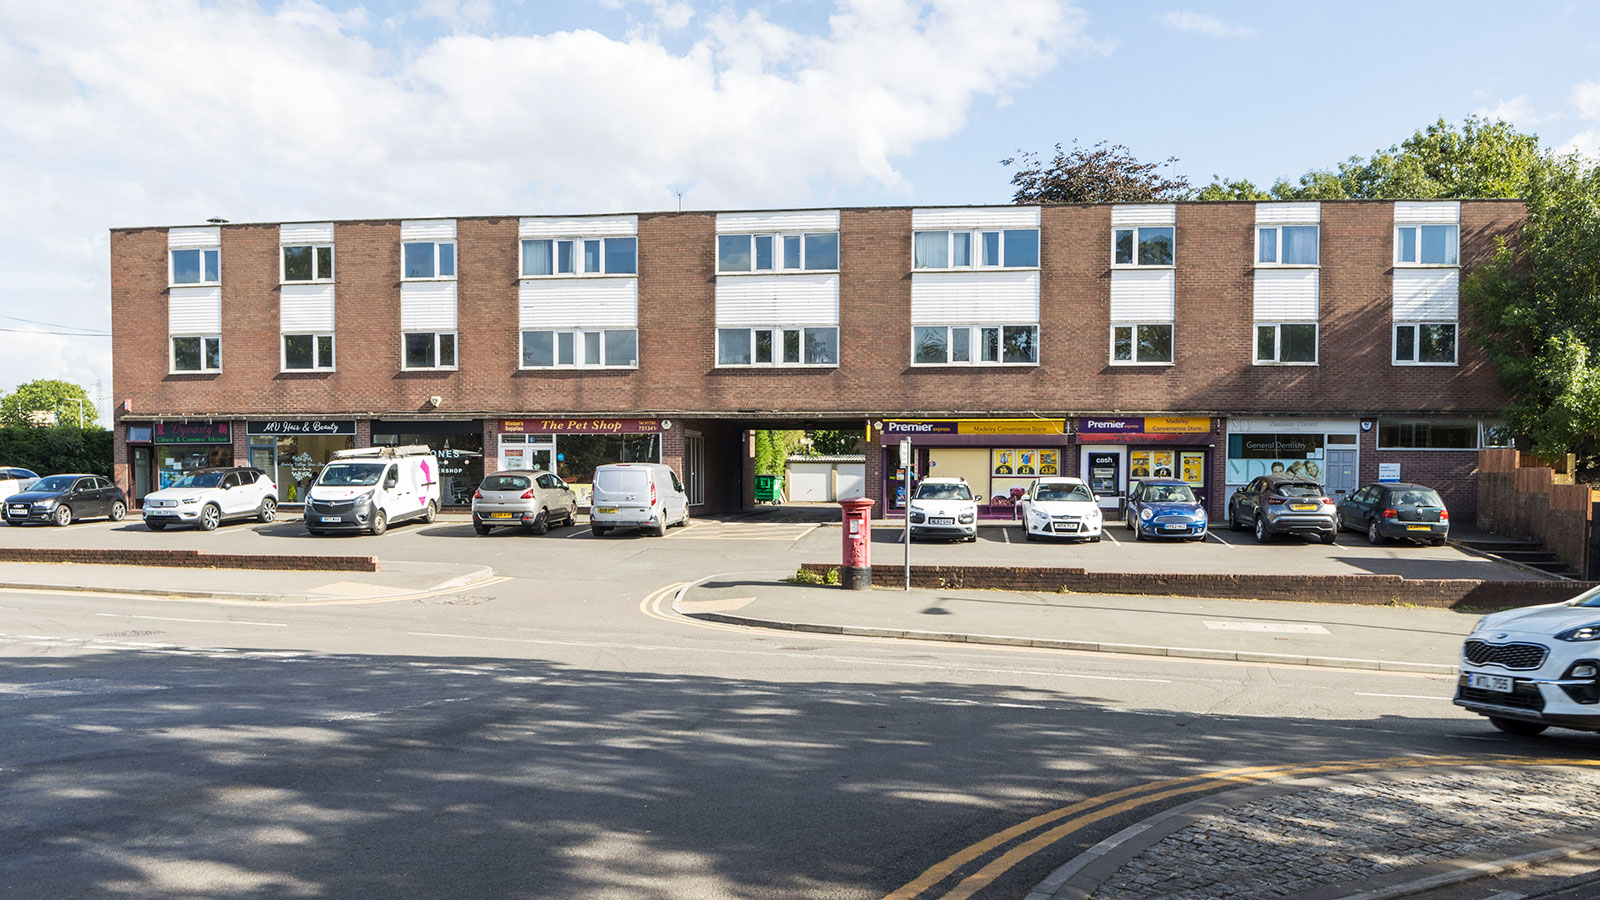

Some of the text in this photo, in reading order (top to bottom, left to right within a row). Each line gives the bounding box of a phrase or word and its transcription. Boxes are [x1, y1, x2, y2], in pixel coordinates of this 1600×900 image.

[263, 421, 339, 434] MV Hair & Beauty
[541, 420, 622, 432] The Pet Shop
[889, 421, 933, 432] Premier
[1088, 419, 1125, 429] Premier
[171, 422, 214, 437] Dynasty
[1246, 441, 1275, 449] General
[1275, 441, 1307, 450] Dentistry
[430, 449, 460, 458] ONES
[1096, 456, 1113, 464] cash
